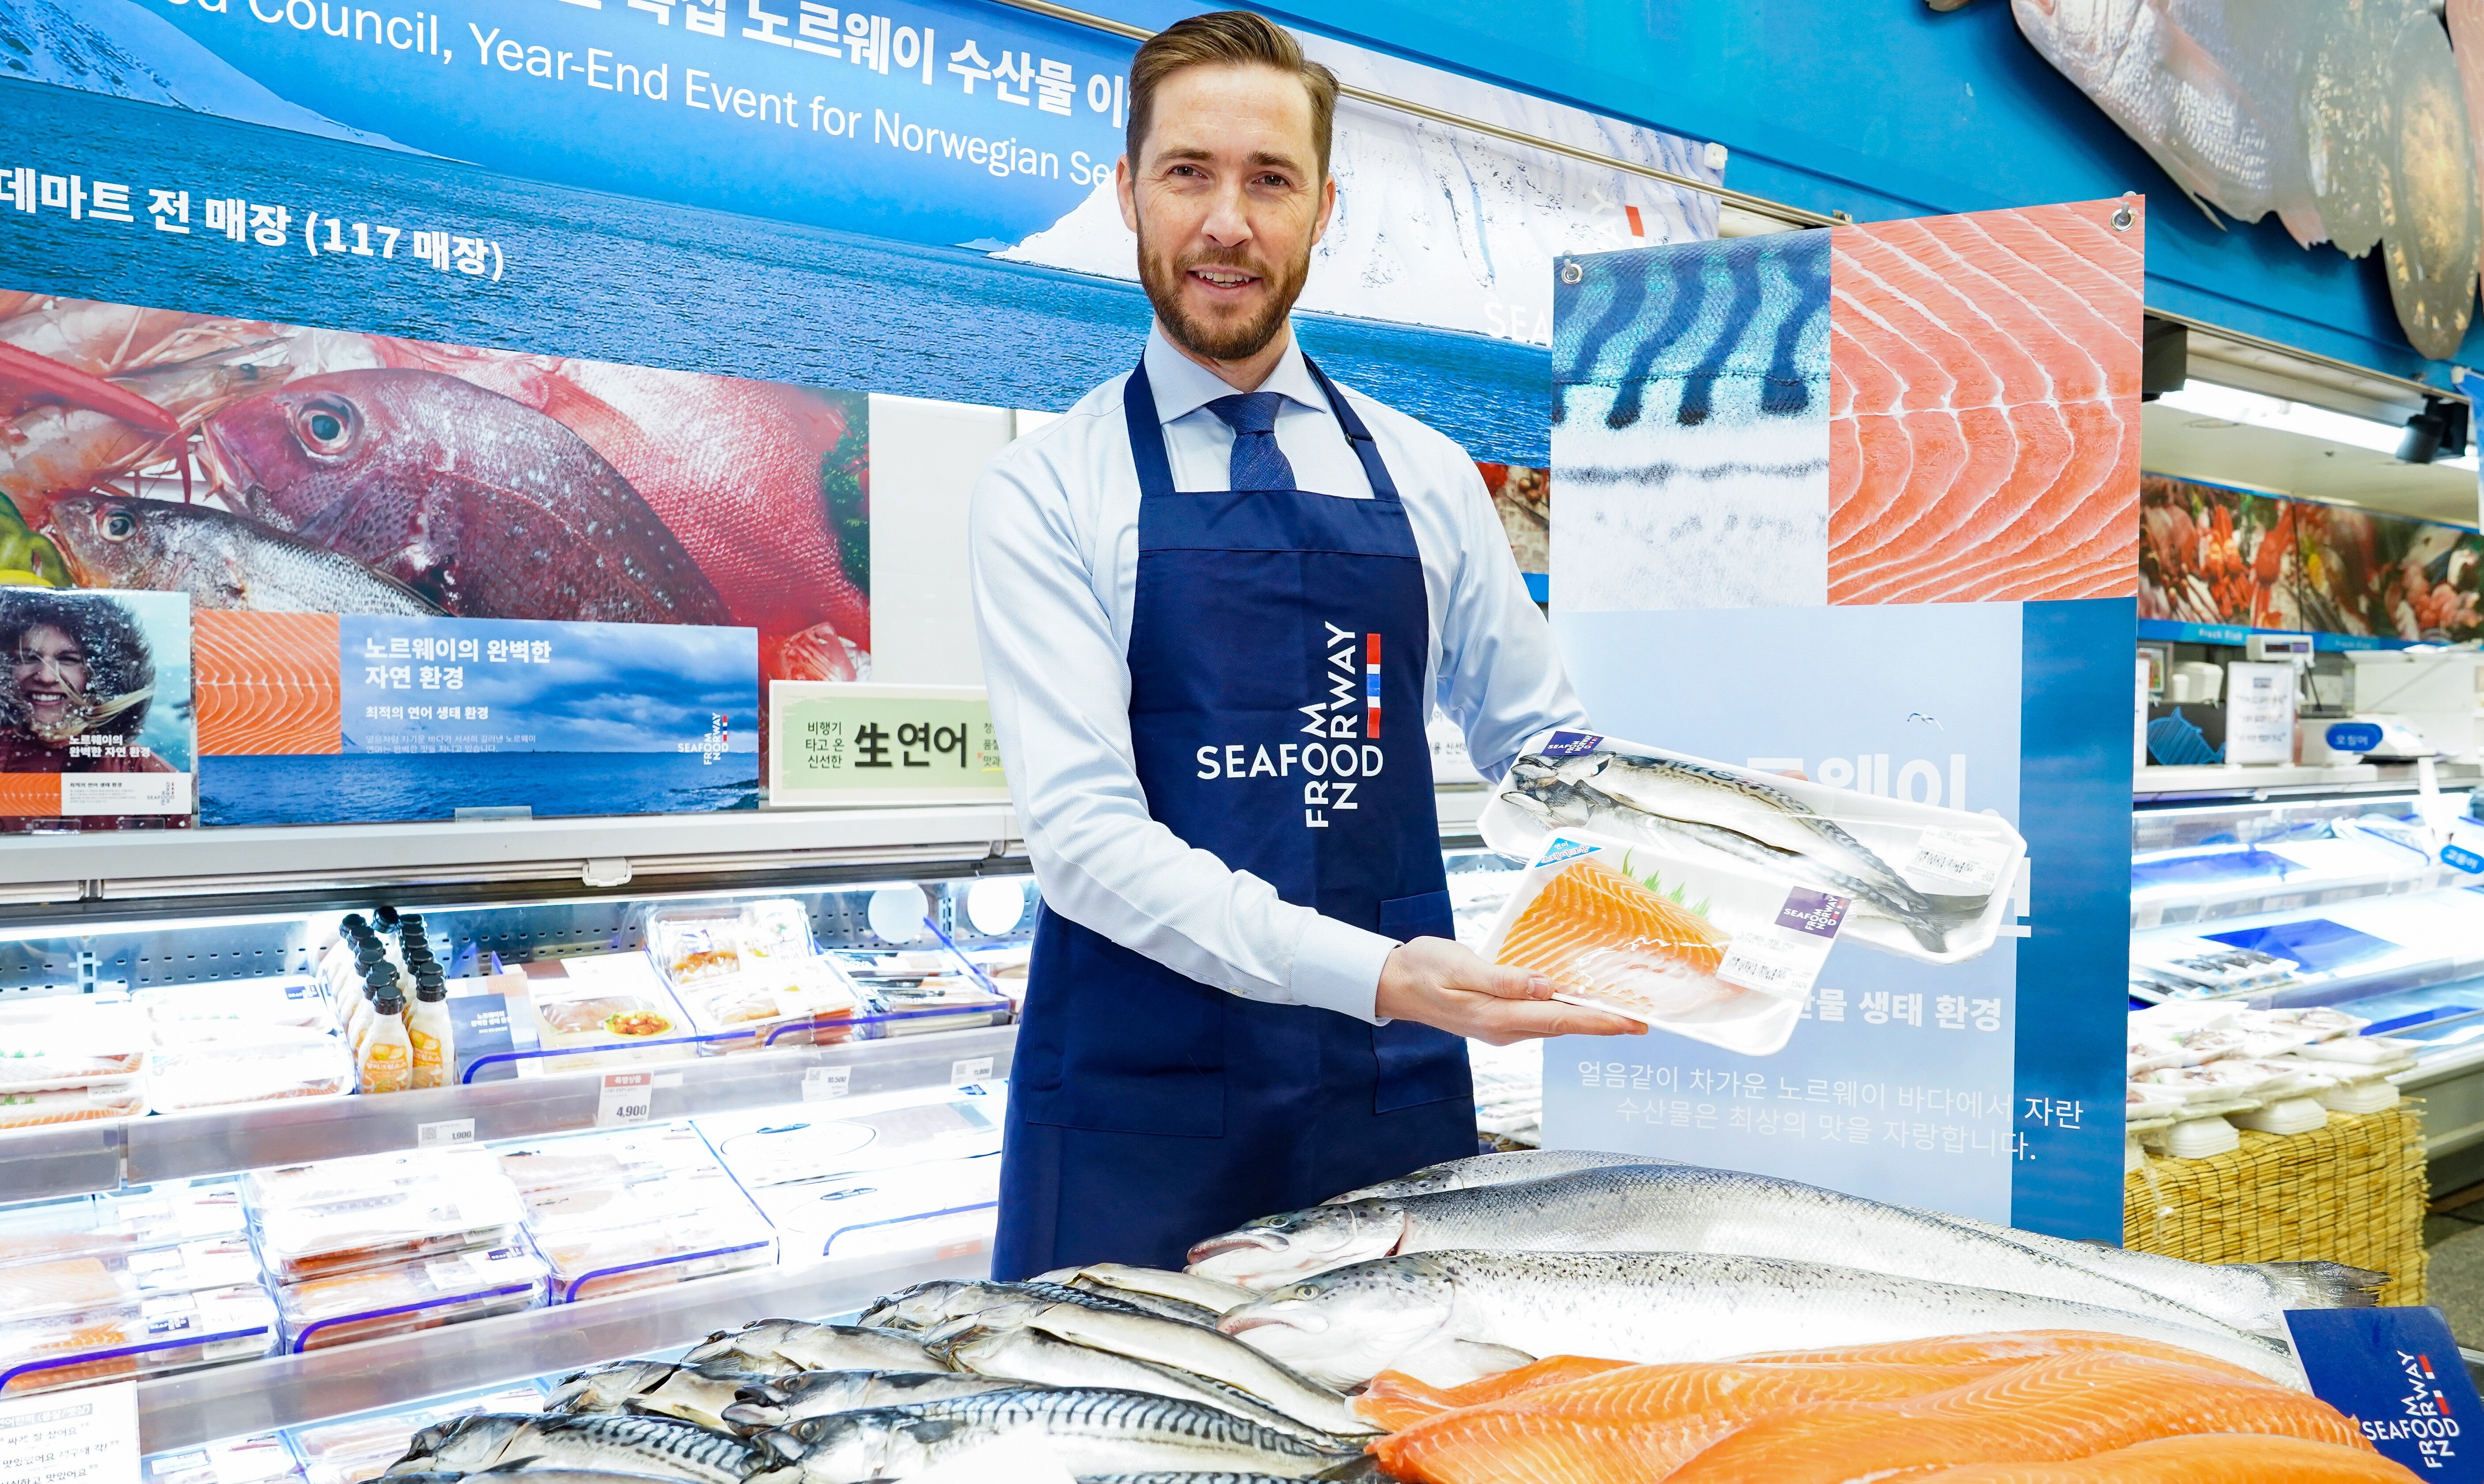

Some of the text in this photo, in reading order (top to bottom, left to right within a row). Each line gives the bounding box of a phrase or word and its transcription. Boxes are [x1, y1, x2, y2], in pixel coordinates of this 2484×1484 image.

[742, 0, 935, 85] 노르웨이
[947, 39, 1076, 117] 수산물
[1087, 74, 1130, 129] 이
[249, 0, 453, 65] Council,
[468, 23, 668, 102] Year-End
[686, 68, 799, 128] Event
[809, 95, 862, 139] for
[875, 109, 1059, 180] Norwegian
[147, 189, 189, 234] 전
[206, 199, 291, 247] 매장
[306, 211, 400, 260] (117
[414, 230, 504, 281] 매장)
[365, 637, 552, 663] 노르웨이의 완벽한
[365, 665, 464, 689] 자연 환경
[366, 706, 488, 720] 최적의 연어 생태 환경
[1325, 621, 1358, 810] NORWAY
[69, 734, 123, 746] 노르웨이의
[807, 721, 842, 734] 비행기
[69, 746, 151, 758] 완벽한 자연 환경
[678, 742, 729, 753] SEAFOOD
[805, 738, 845, 752] 타고 온
[807, 754, 842, 769] 신선한
[1197, 742, 1383, 780] SEAFOOD
[1298, 702, 1329, 827] FROM
[1783, 908, 1837, 926] SEAFOOD
[1859, 991, 1923, 1027] 생태
[1935, 994, 2001, 1032] 환경
[1578, 1061, 2085, 1131] 얼음같이 차가운 노르웨이 바다에서 자란
[616, 1104, 647, 1118] 4,900
[1615, 1095, 2037, 1162] 수산물은 최상의 맛을 자랑합니다.
[2397, 1350, 2456, 1457] NORWAY
[2362, 1418, 2461, 1442] SEAFOOD
[2401, 1396, 2443, 1468] FROM
